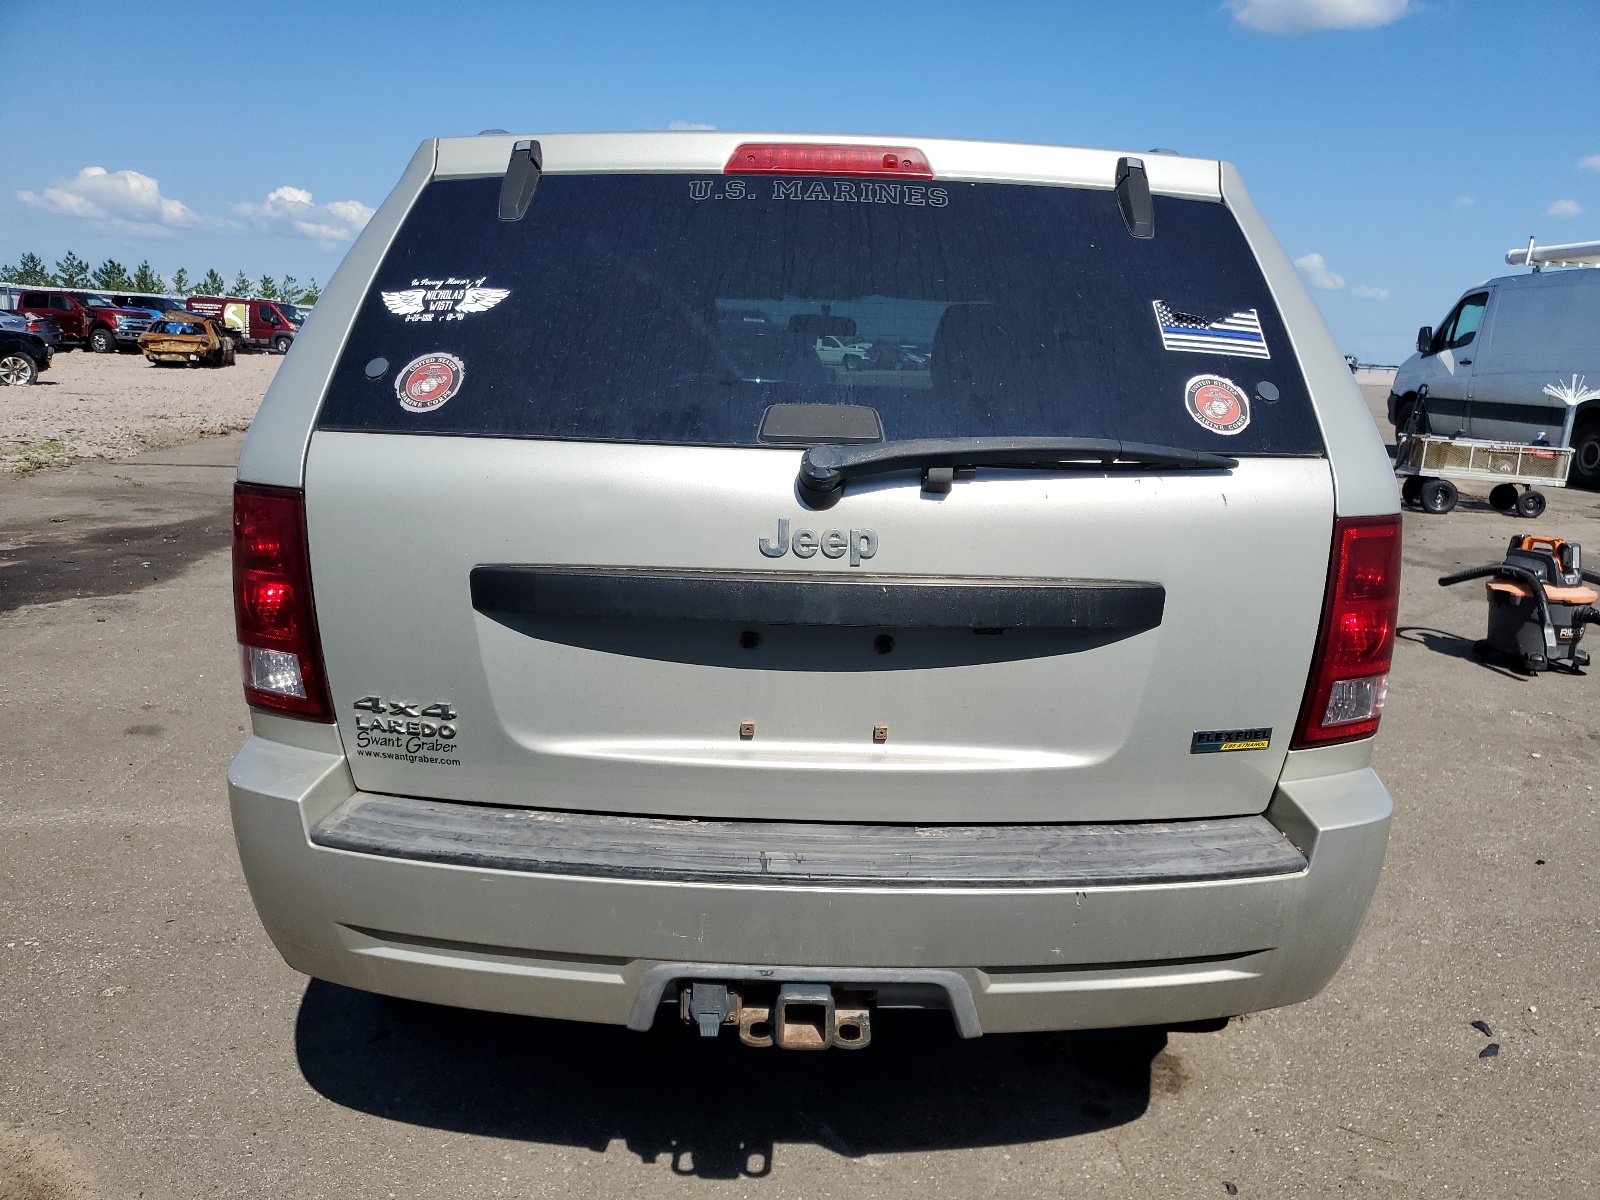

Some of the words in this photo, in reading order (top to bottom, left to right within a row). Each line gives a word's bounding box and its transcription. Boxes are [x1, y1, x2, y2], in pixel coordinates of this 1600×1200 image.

[689, 181, 756, 200] U.S.
[772, 181, 949, 207] MARINES
[409, 358, 436, 373] UNITED
[437, 358, 459, 372] STATES
[1190, 380, 1211, 393] UNITED
[1213, 380, 1239, 396] STATES
[400, 390, 423, 408] MARINE
[427, 390, 453, 407] CORPS
[1195, 412, 1225, 430] MARINE
[1228, 414, 1247, 430] CORPS
[759, 518, 879, 567] Jeep
[355, 714, 457, 739] LAREDO
[357, 731, 403, 748] Swant
[405, 736, 457, 754] Graber
[356, 749, 460, 766] www.swantgraber.com
